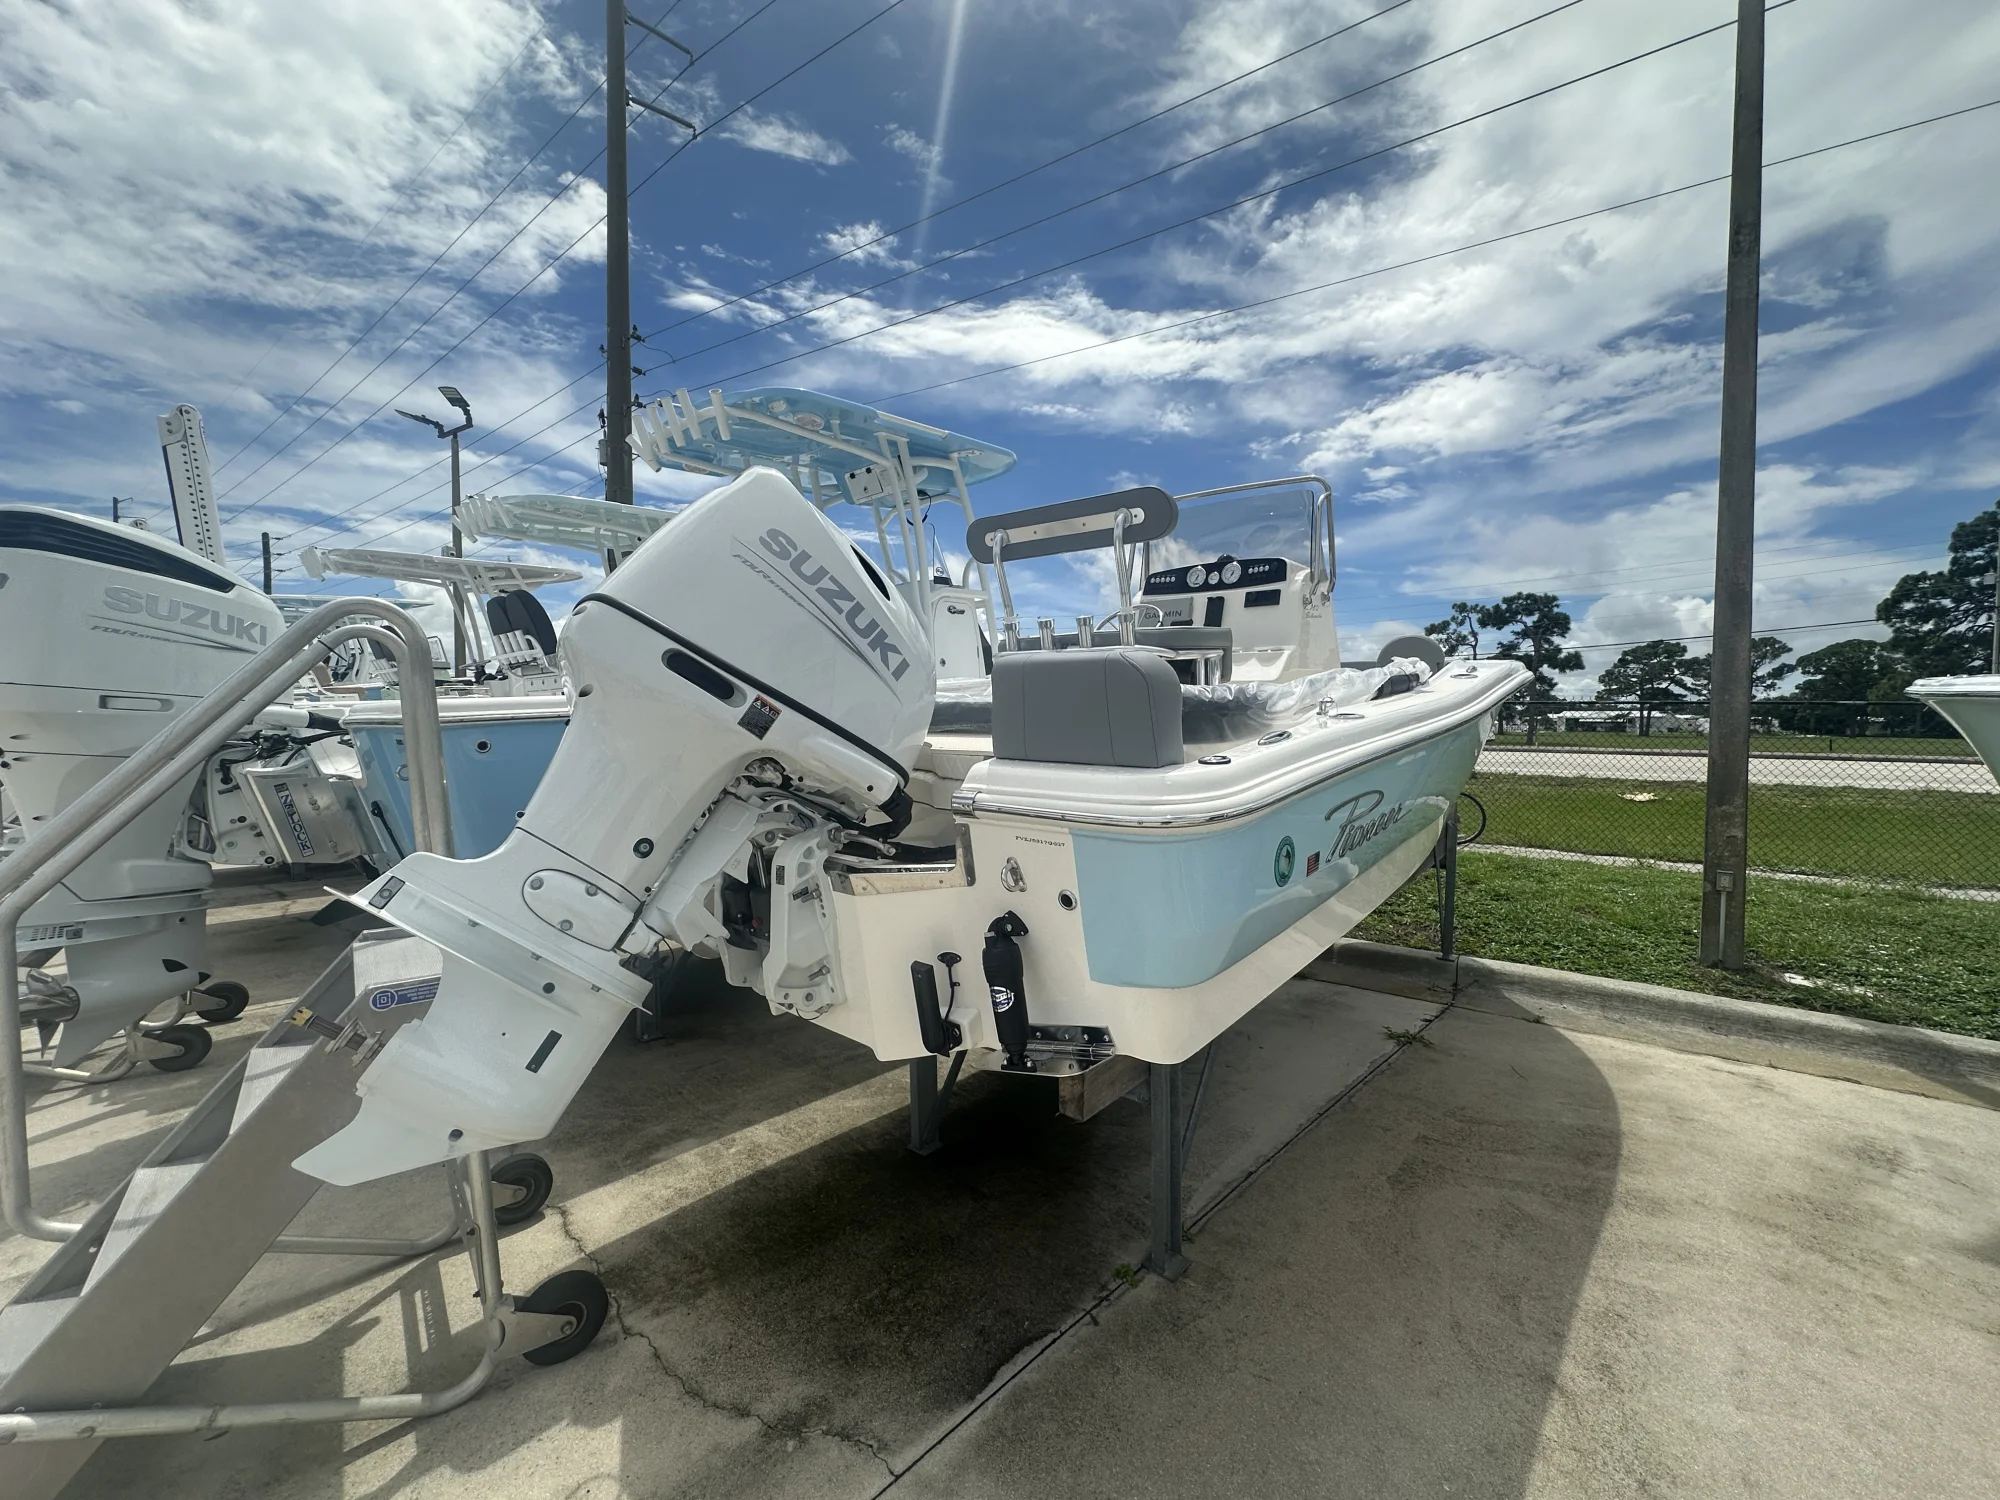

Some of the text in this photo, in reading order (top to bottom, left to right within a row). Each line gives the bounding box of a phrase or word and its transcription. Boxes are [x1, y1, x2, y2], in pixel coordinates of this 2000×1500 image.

[104, 586, 267, 646] SUZUKI
[758, 528, 910, 682] SUZUKI
[1144, 610, 1183, 620] GAMIN
[1324, 789, 1413, 863] Pioneer
